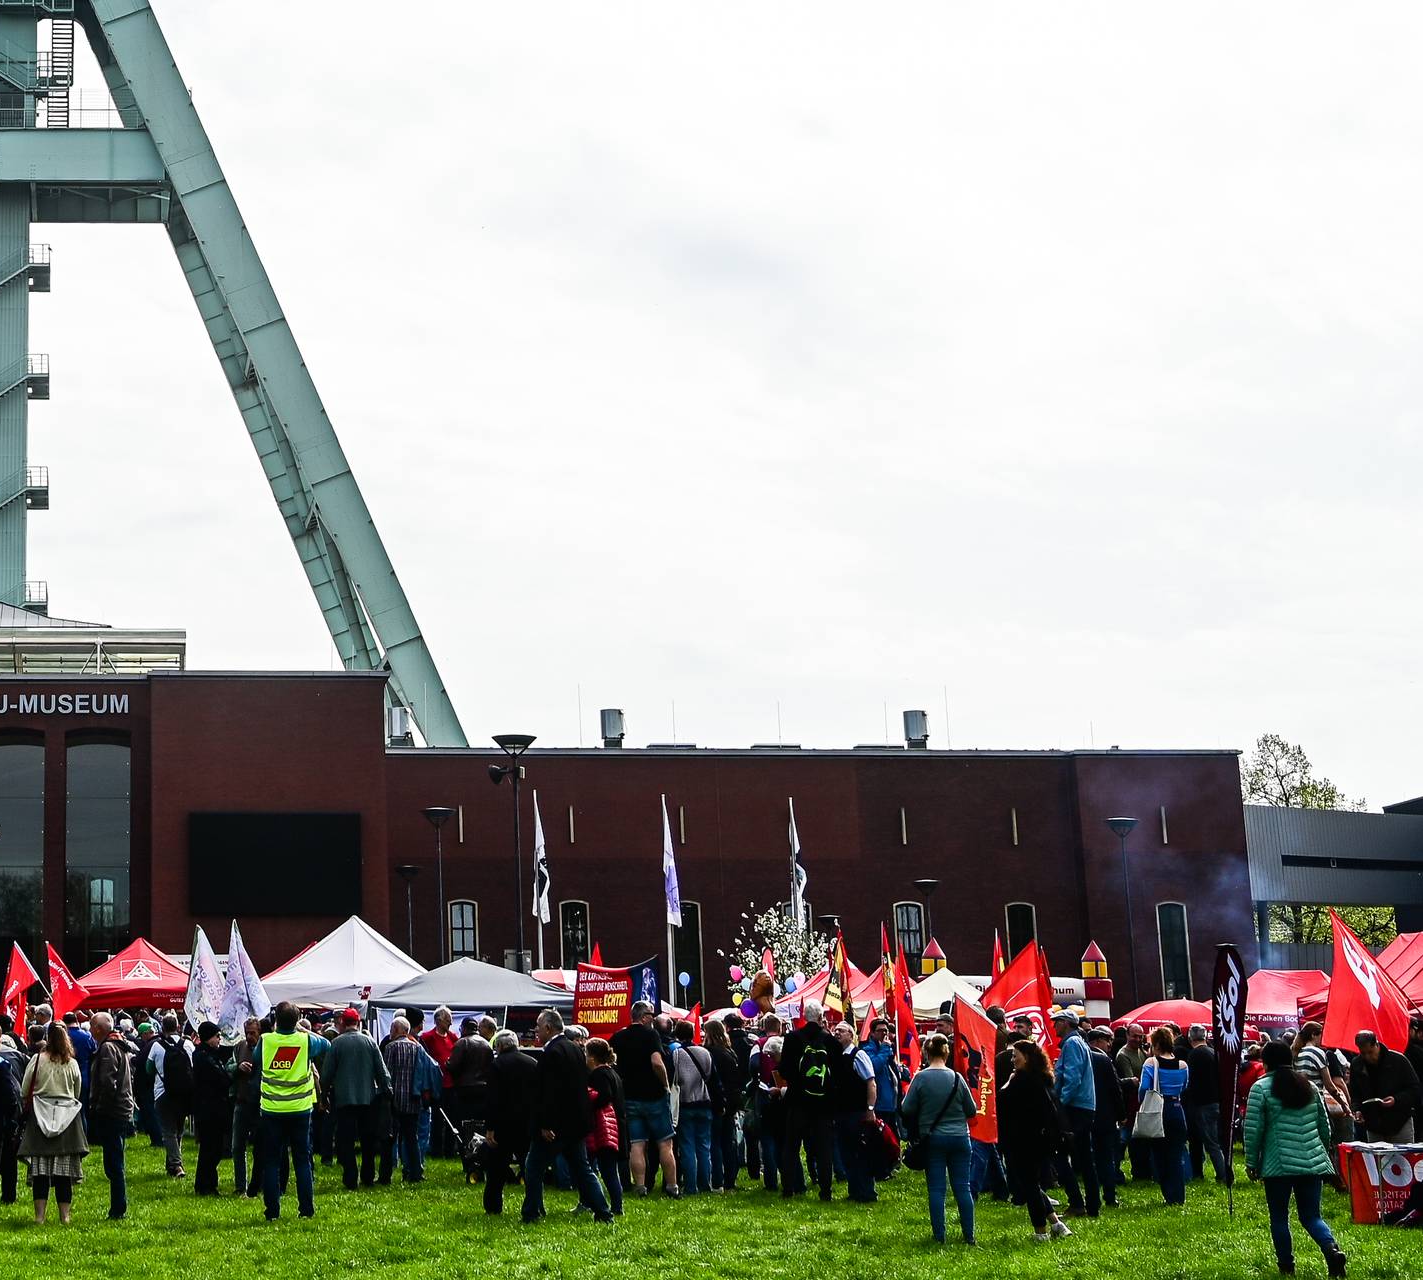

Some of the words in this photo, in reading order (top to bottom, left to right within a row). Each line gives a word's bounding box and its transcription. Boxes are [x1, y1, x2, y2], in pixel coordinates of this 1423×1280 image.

[604, 993, 628, 1007] ECHTER
[578, 1010, 618, 1024] SOZIALISMUS!
[272, 1061, 291, 1069] DGB
